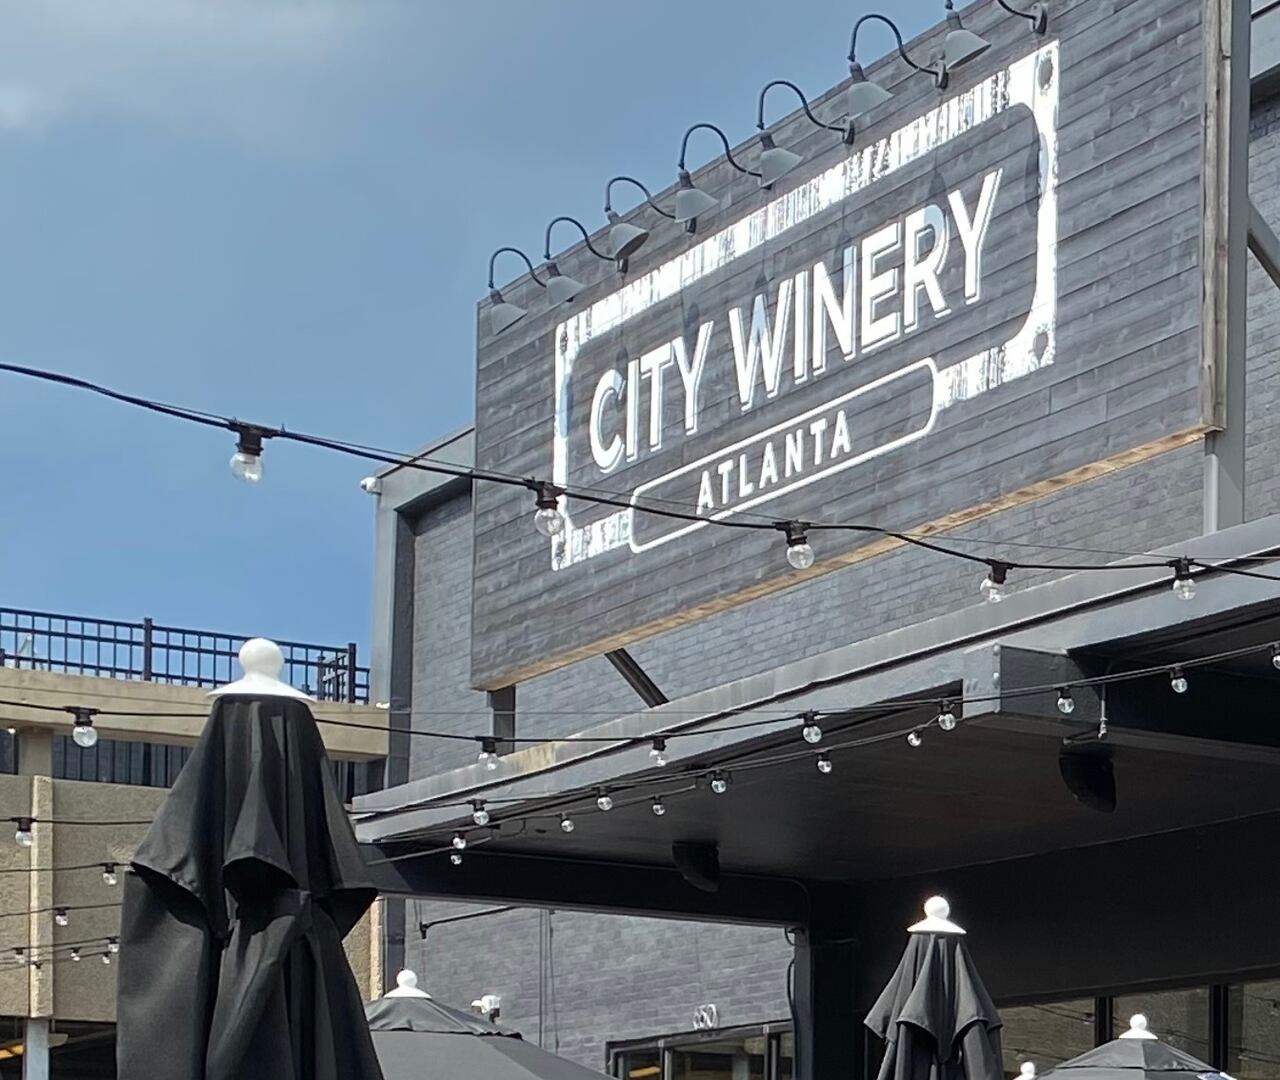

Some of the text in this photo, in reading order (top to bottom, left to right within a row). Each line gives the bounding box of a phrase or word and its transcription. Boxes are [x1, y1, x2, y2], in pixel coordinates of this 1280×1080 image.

[589, 168, 1003, 474] CITY WINERY
[697, 411, 852, 515] ATLANTA
